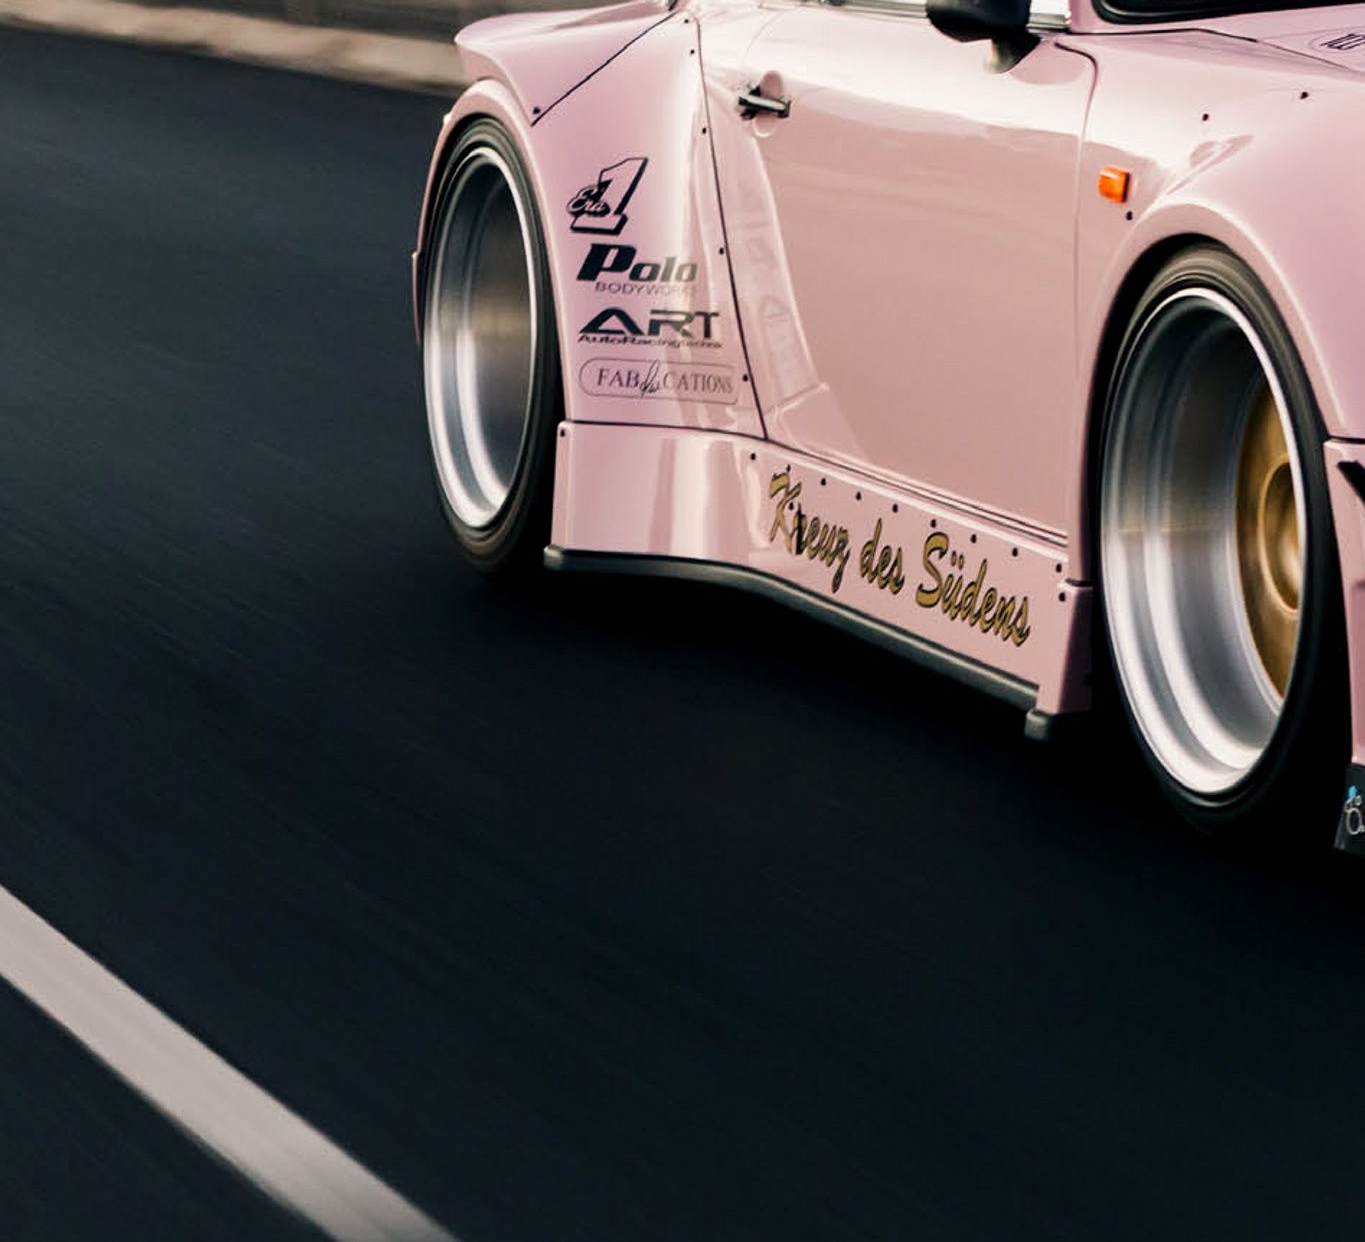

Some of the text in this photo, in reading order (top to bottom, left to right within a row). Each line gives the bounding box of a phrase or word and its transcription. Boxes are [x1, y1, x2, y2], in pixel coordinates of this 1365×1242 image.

[576, 242, 698, 282] Polo
[578, 307, 720, 339] ART
[769, 471, 1031, 647] Kreuz des Südens
